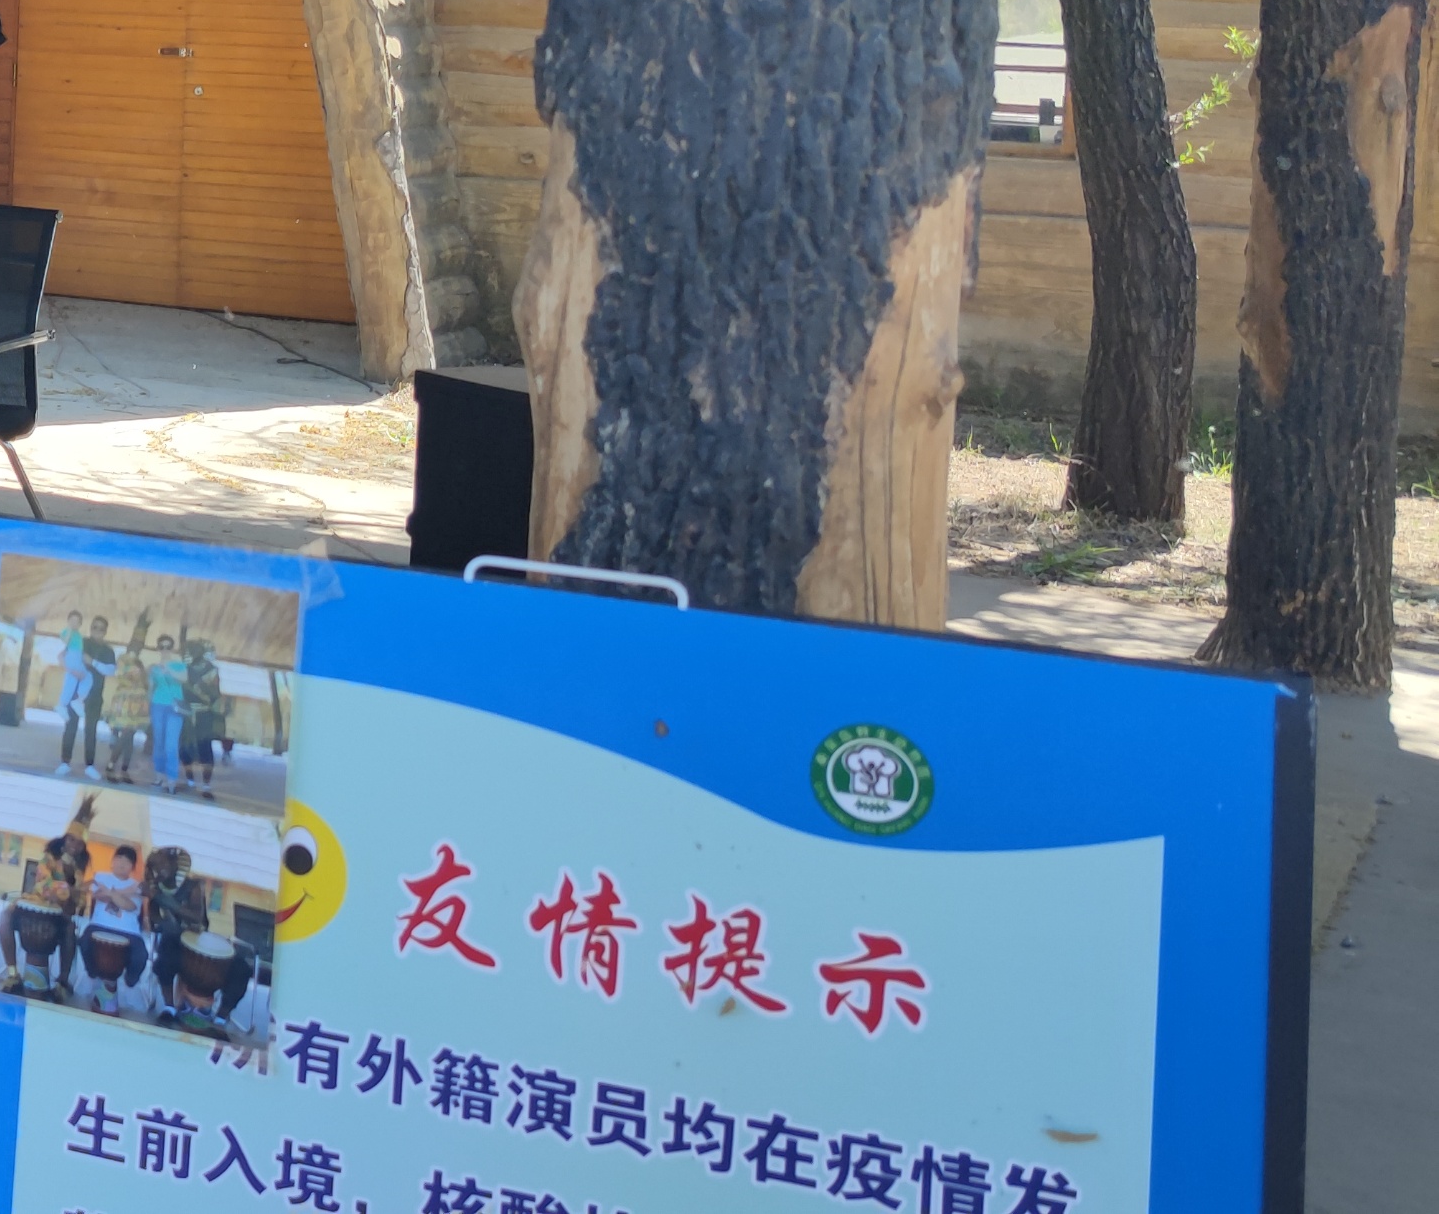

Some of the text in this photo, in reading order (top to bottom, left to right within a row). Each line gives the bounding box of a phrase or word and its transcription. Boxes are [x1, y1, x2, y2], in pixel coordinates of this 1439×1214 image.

[397, 843, 926, 1035] 友情提示
[66, 1094, 630, 1214] 生前入境，核
